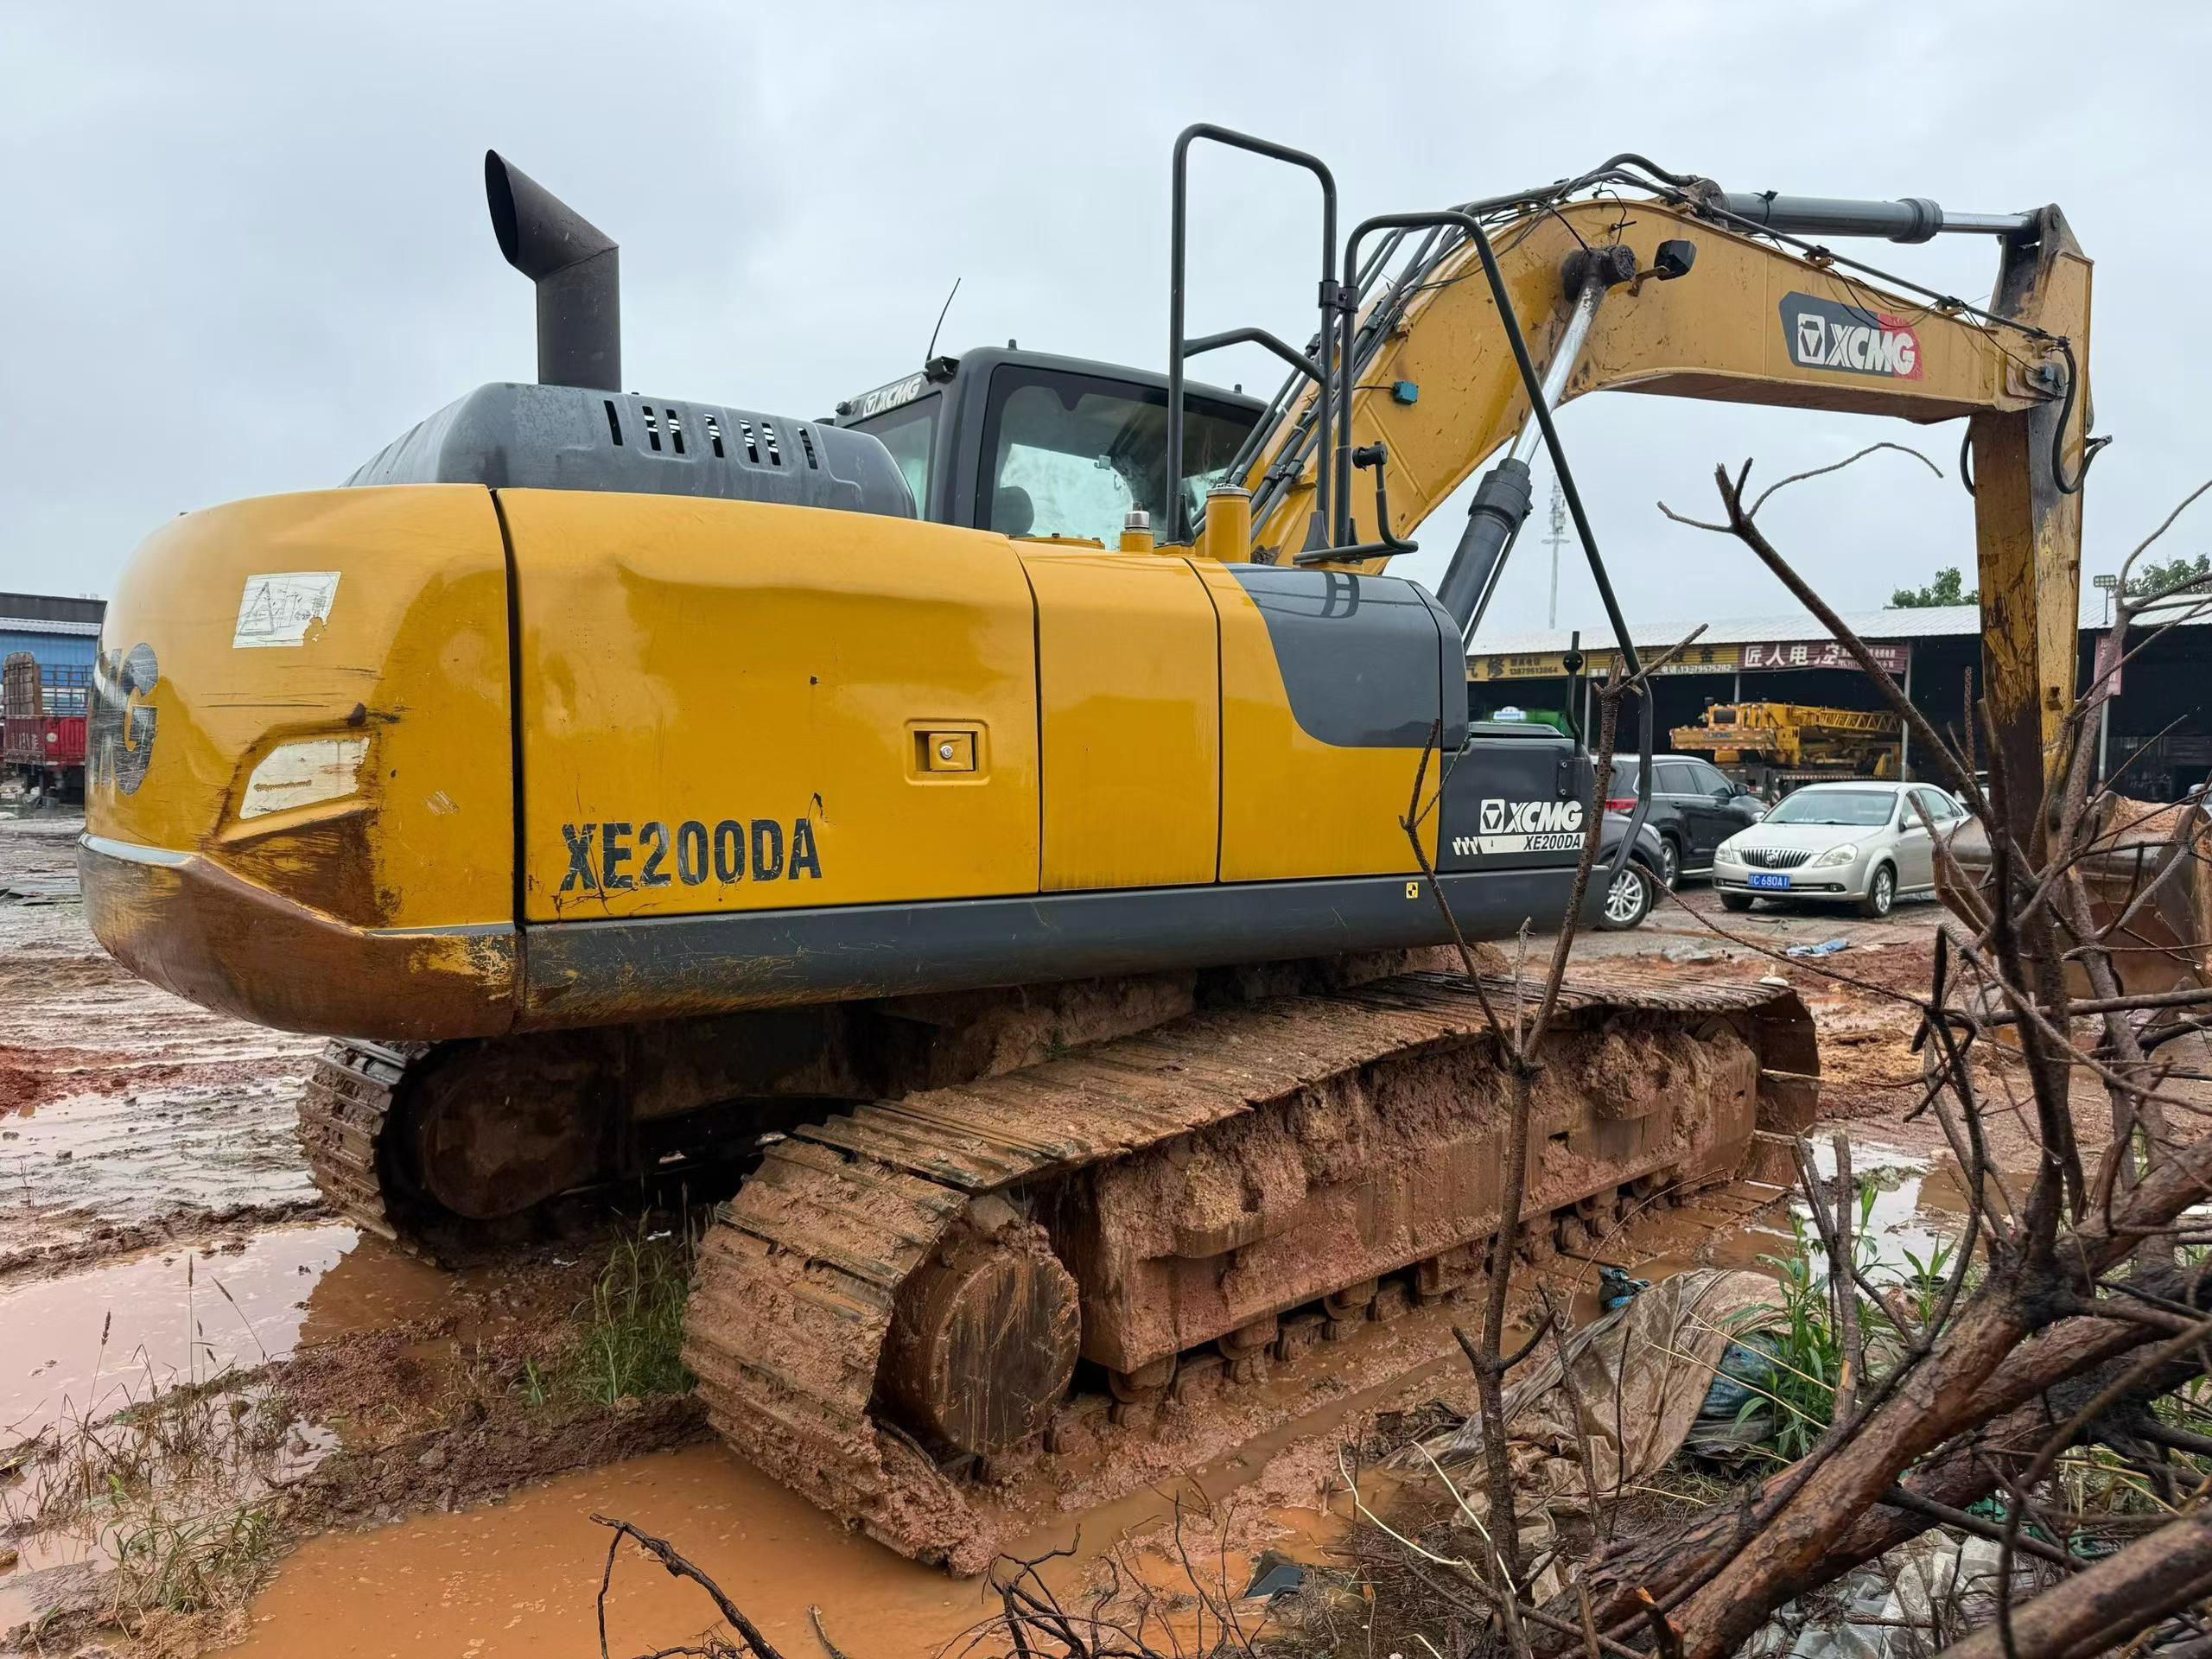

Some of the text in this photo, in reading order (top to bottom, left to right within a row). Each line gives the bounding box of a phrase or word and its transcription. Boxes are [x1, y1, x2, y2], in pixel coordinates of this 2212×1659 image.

[1825, 323, 1916, 375] XCMG
[875, 377, 922, 415] XCMG
[1503, 800, 1583, 833] XCMG
[562, 818, 823, 891] XE200DA
[1523, 834, 1581, 851] XE200DA
